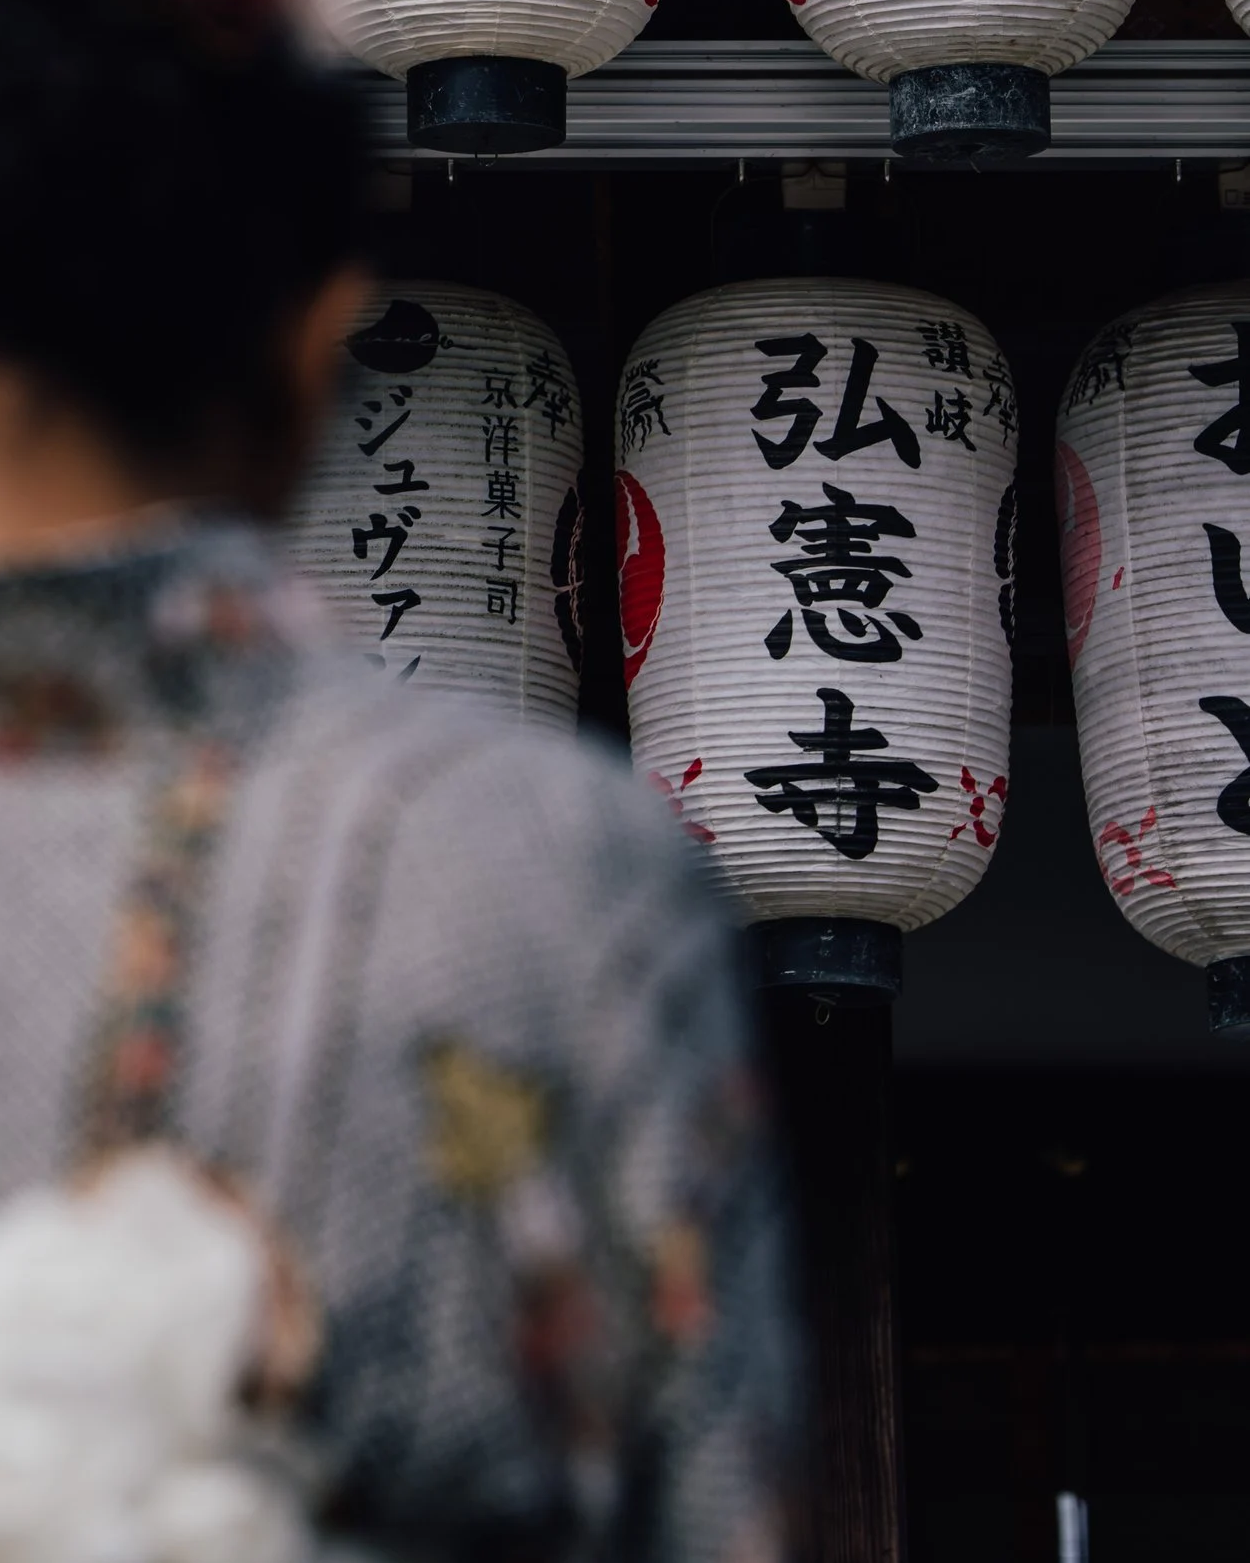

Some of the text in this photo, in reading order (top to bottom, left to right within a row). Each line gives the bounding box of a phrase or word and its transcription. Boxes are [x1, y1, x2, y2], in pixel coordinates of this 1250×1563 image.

[481, 367, 521, 626] 京洋菓子司
[743, 332, 940, 861] 弘憲寺
